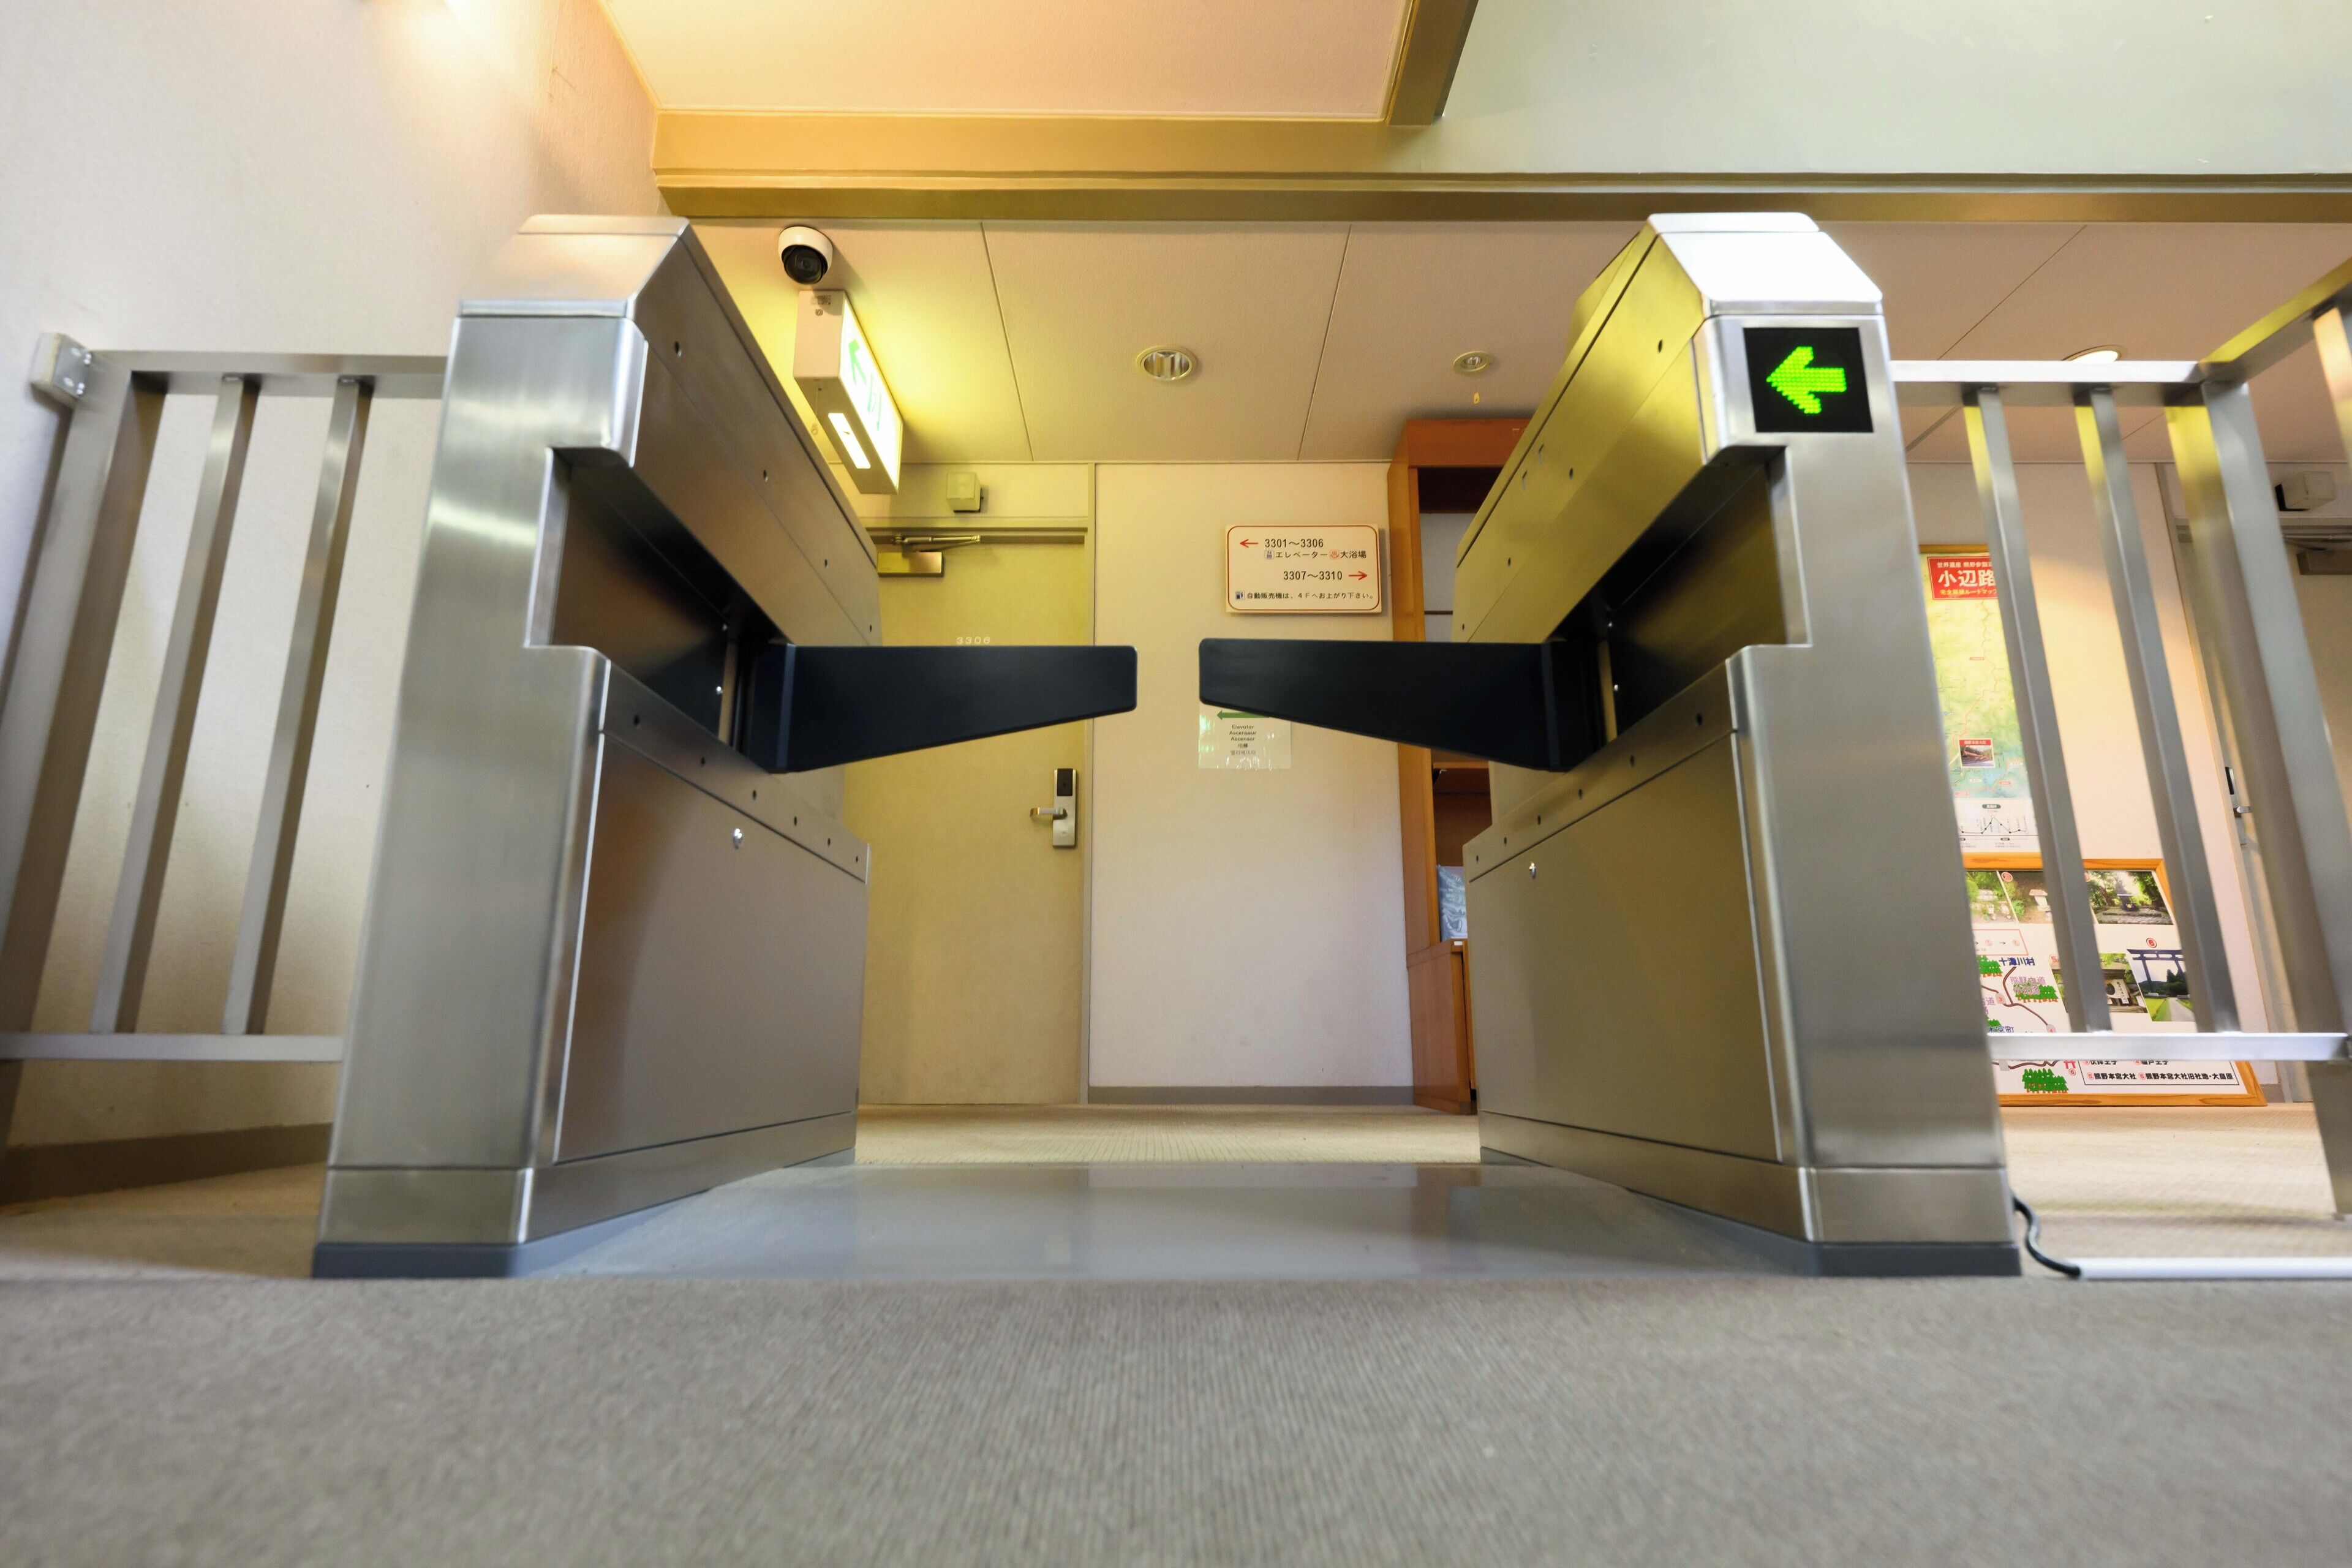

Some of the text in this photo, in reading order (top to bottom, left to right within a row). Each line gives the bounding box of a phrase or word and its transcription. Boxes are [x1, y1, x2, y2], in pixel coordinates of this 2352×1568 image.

[1264, 538, 1324, 548] 3301～3306
[1283, 571, 1343, 580] 3307～3310
[1937, 570, 1996, 587] 小辺路
